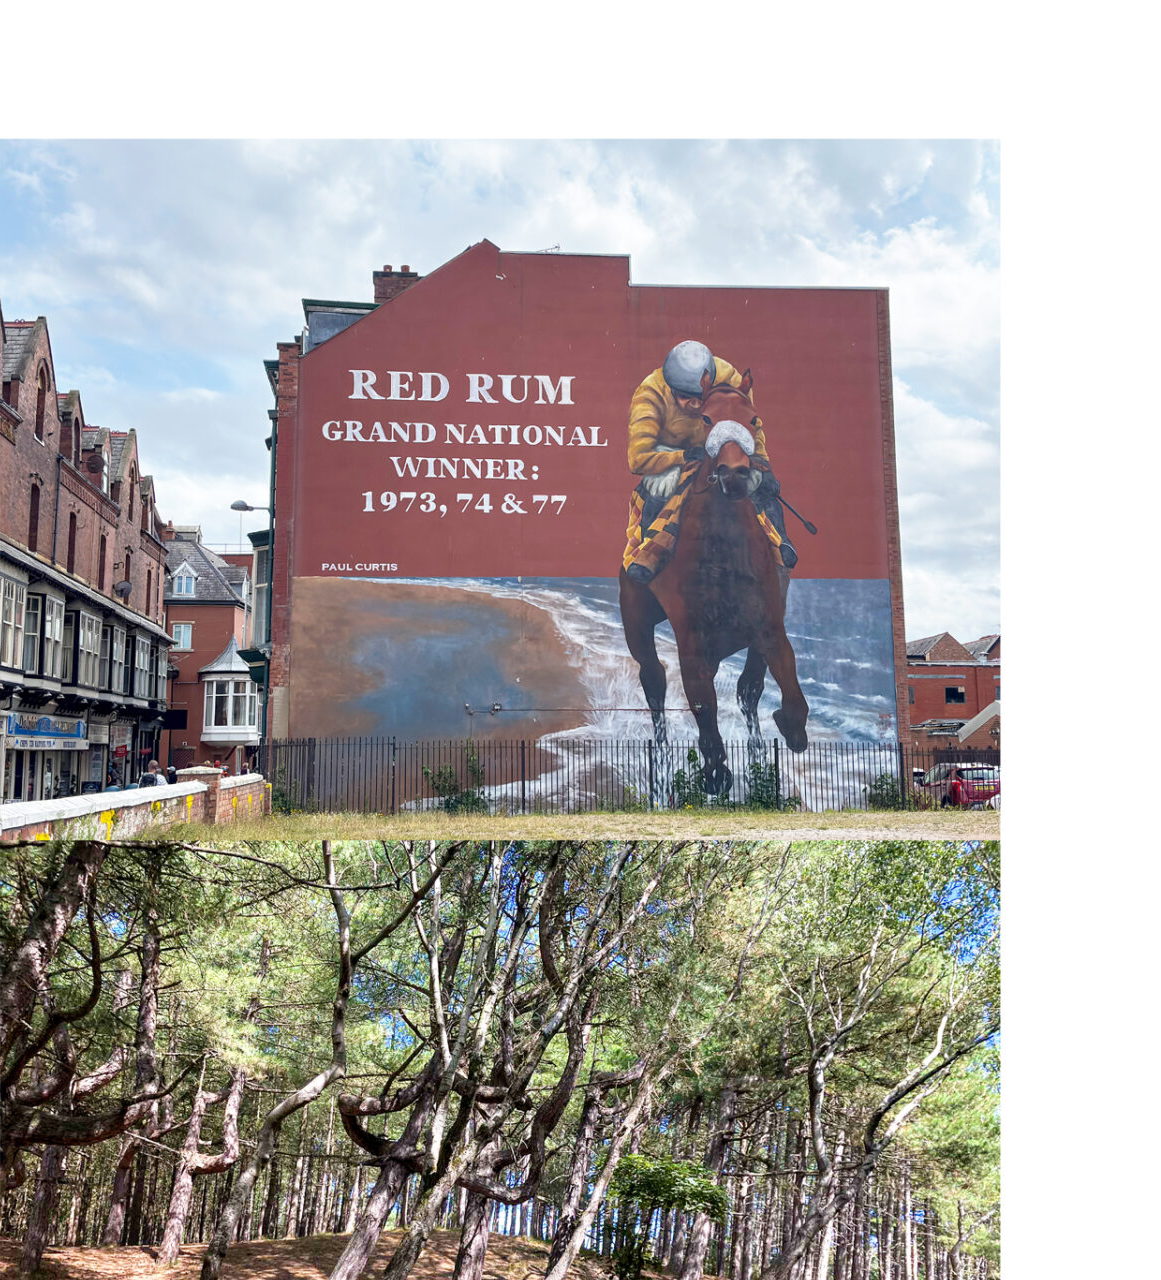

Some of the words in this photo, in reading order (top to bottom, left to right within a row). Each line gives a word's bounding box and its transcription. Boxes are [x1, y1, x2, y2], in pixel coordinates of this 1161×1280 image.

[348, 369, 450, 401] RED
[465, 373, 576, 405] RUM
[321, 420, 437, 443] GRAND
[443, 424, 608, 447] NATIONAL
[389, 456, 539, 480] WINNER:
[361, 491, 447, 518] 1973,
[456, 493, 494, 514] 74
[500, 493, 528, 515] &
[532, 494, 568, 515] 77
[321, 563, 353, 572] PAUL
[355, 563, 398, 572] CURTIS
